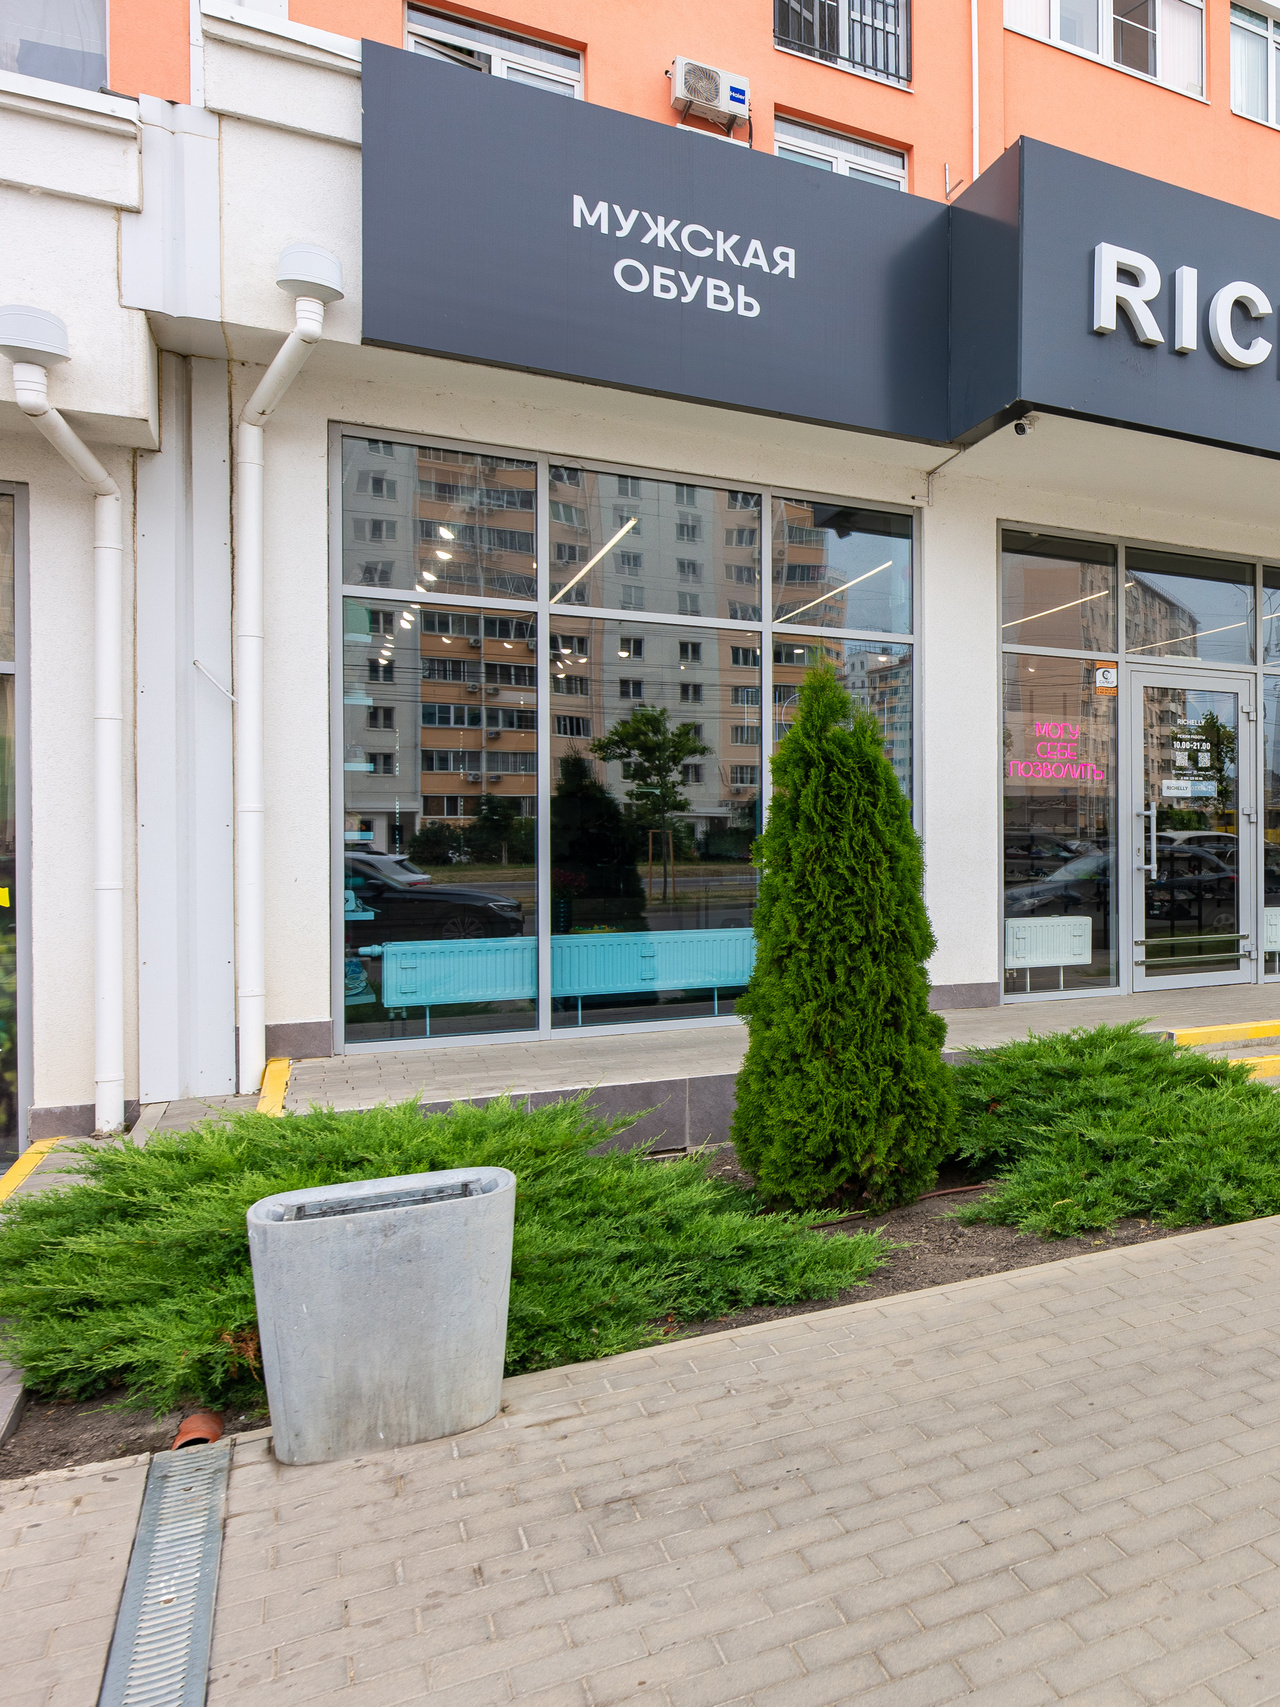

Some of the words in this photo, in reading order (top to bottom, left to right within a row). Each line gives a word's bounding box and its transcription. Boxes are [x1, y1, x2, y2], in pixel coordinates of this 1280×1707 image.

[573, 194, 796, 279] МУЖСКАЯ
[613, 258, 761, 318] ОБУВЬ
[1036, 722, 1079, 739] МОГУ
[1036, 741, 1077, 759] СЕБЕ
[1173, 741, 1210, 750] 10.00-21.00
[1010, 760, 1104, 780] ПОЗВОЛИТЬ
